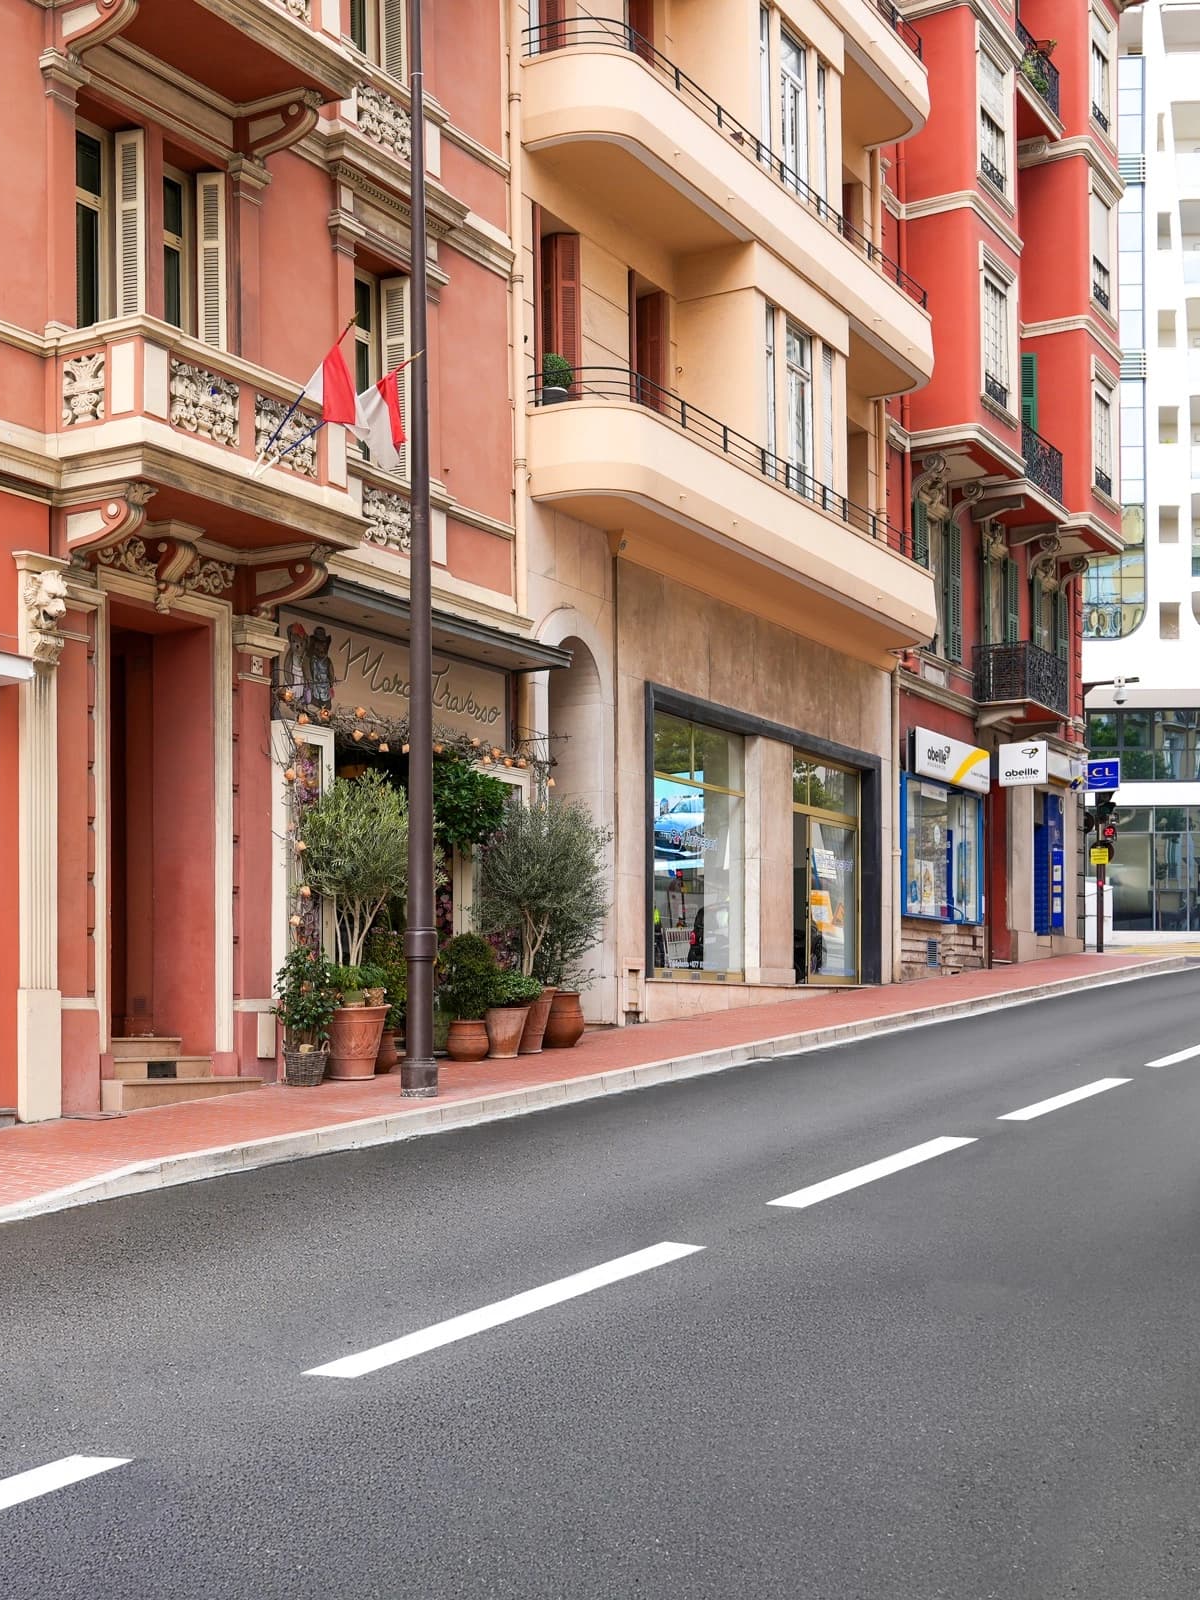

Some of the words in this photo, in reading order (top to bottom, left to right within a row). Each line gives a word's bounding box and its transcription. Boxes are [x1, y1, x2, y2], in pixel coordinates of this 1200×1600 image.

[431, 664, 502, 725] Traverso
[1004, 767, 1040, 778] abeille
[1104, 828, 1113, 836] 22
